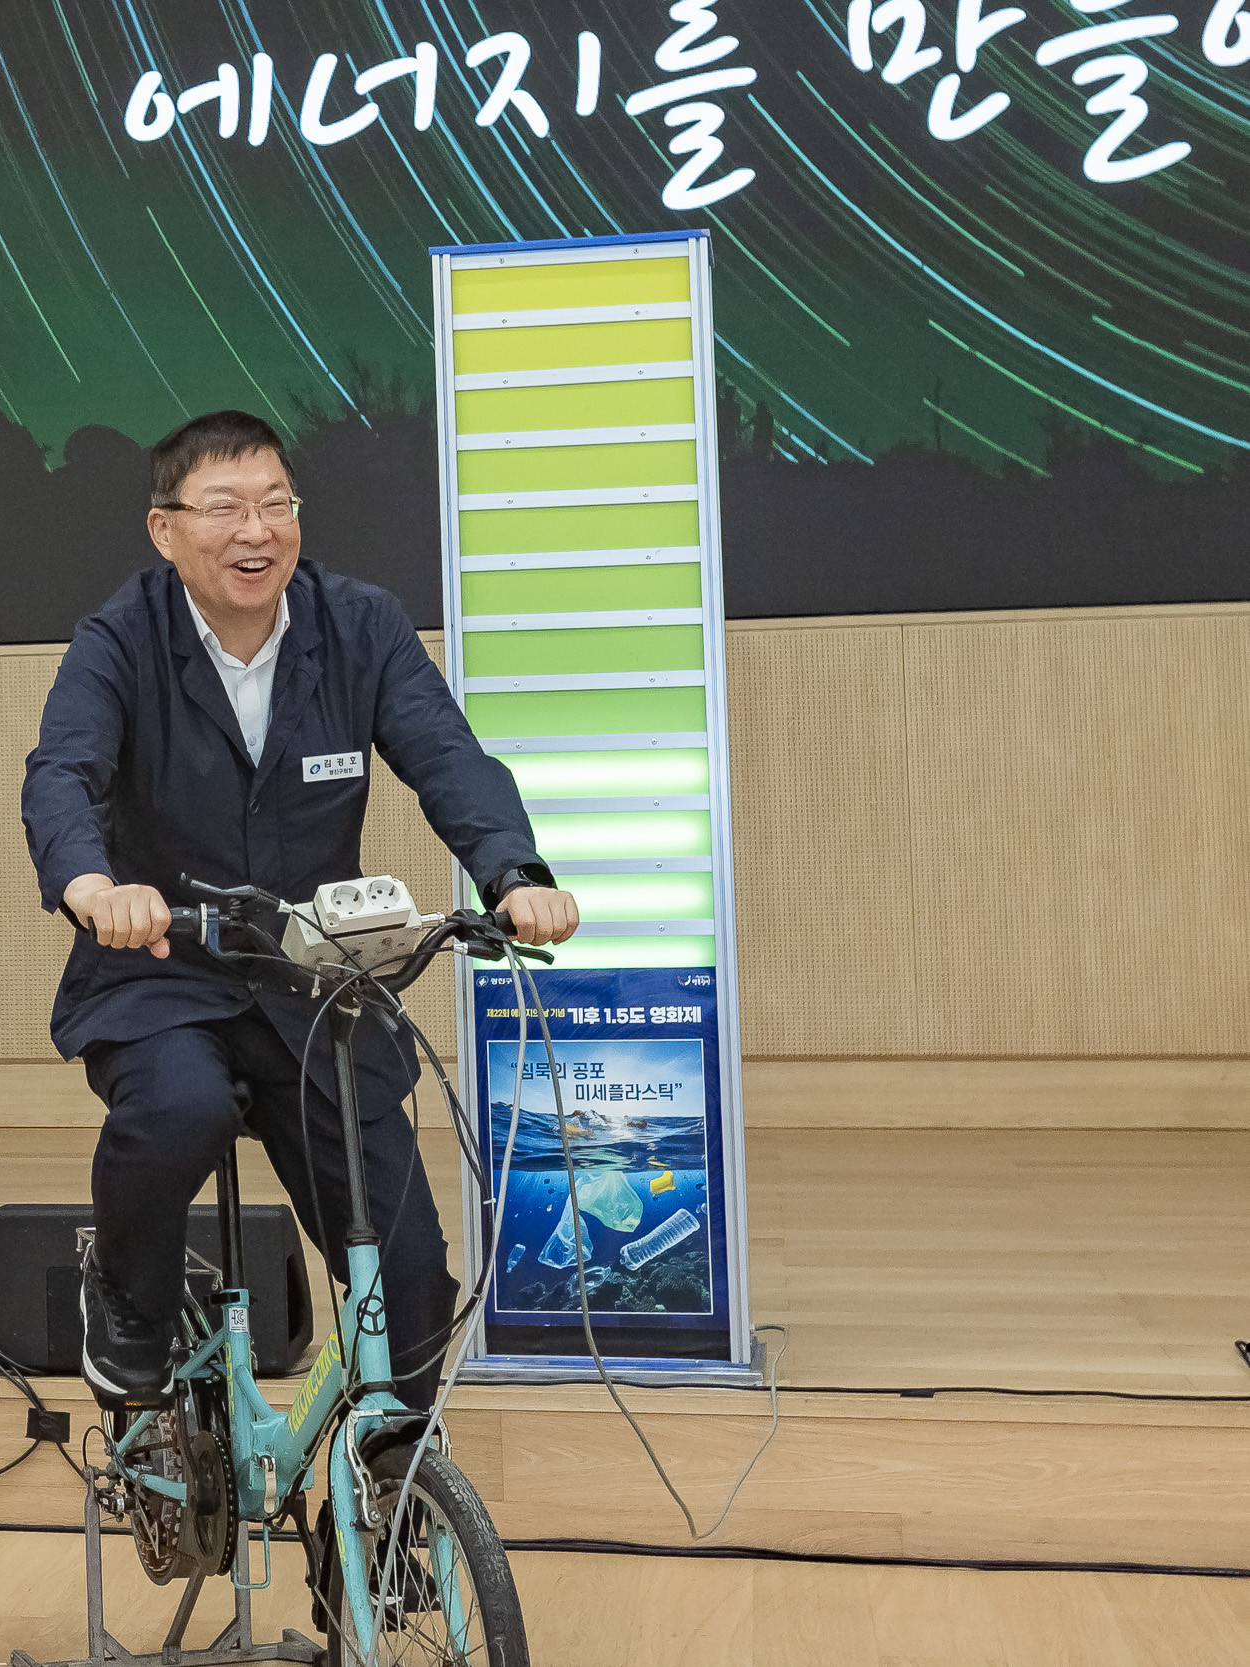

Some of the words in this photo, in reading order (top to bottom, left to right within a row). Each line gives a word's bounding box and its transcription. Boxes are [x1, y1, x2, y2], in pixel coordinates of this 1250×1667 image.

[124, 0, 757, 209] 에너지를
[486, 1008, 510, 1018] 제22회
[510, 1008, 540, 1018] 에지의
[550, 1008, 565, 1018] 기념
[567, 1006, 601, 1025] 기후
[604, 1006, 646, 1024] 1.5도
[649, 1006, 702, 1024] 영화제
[573, 1062, 606, 1080] 공포
